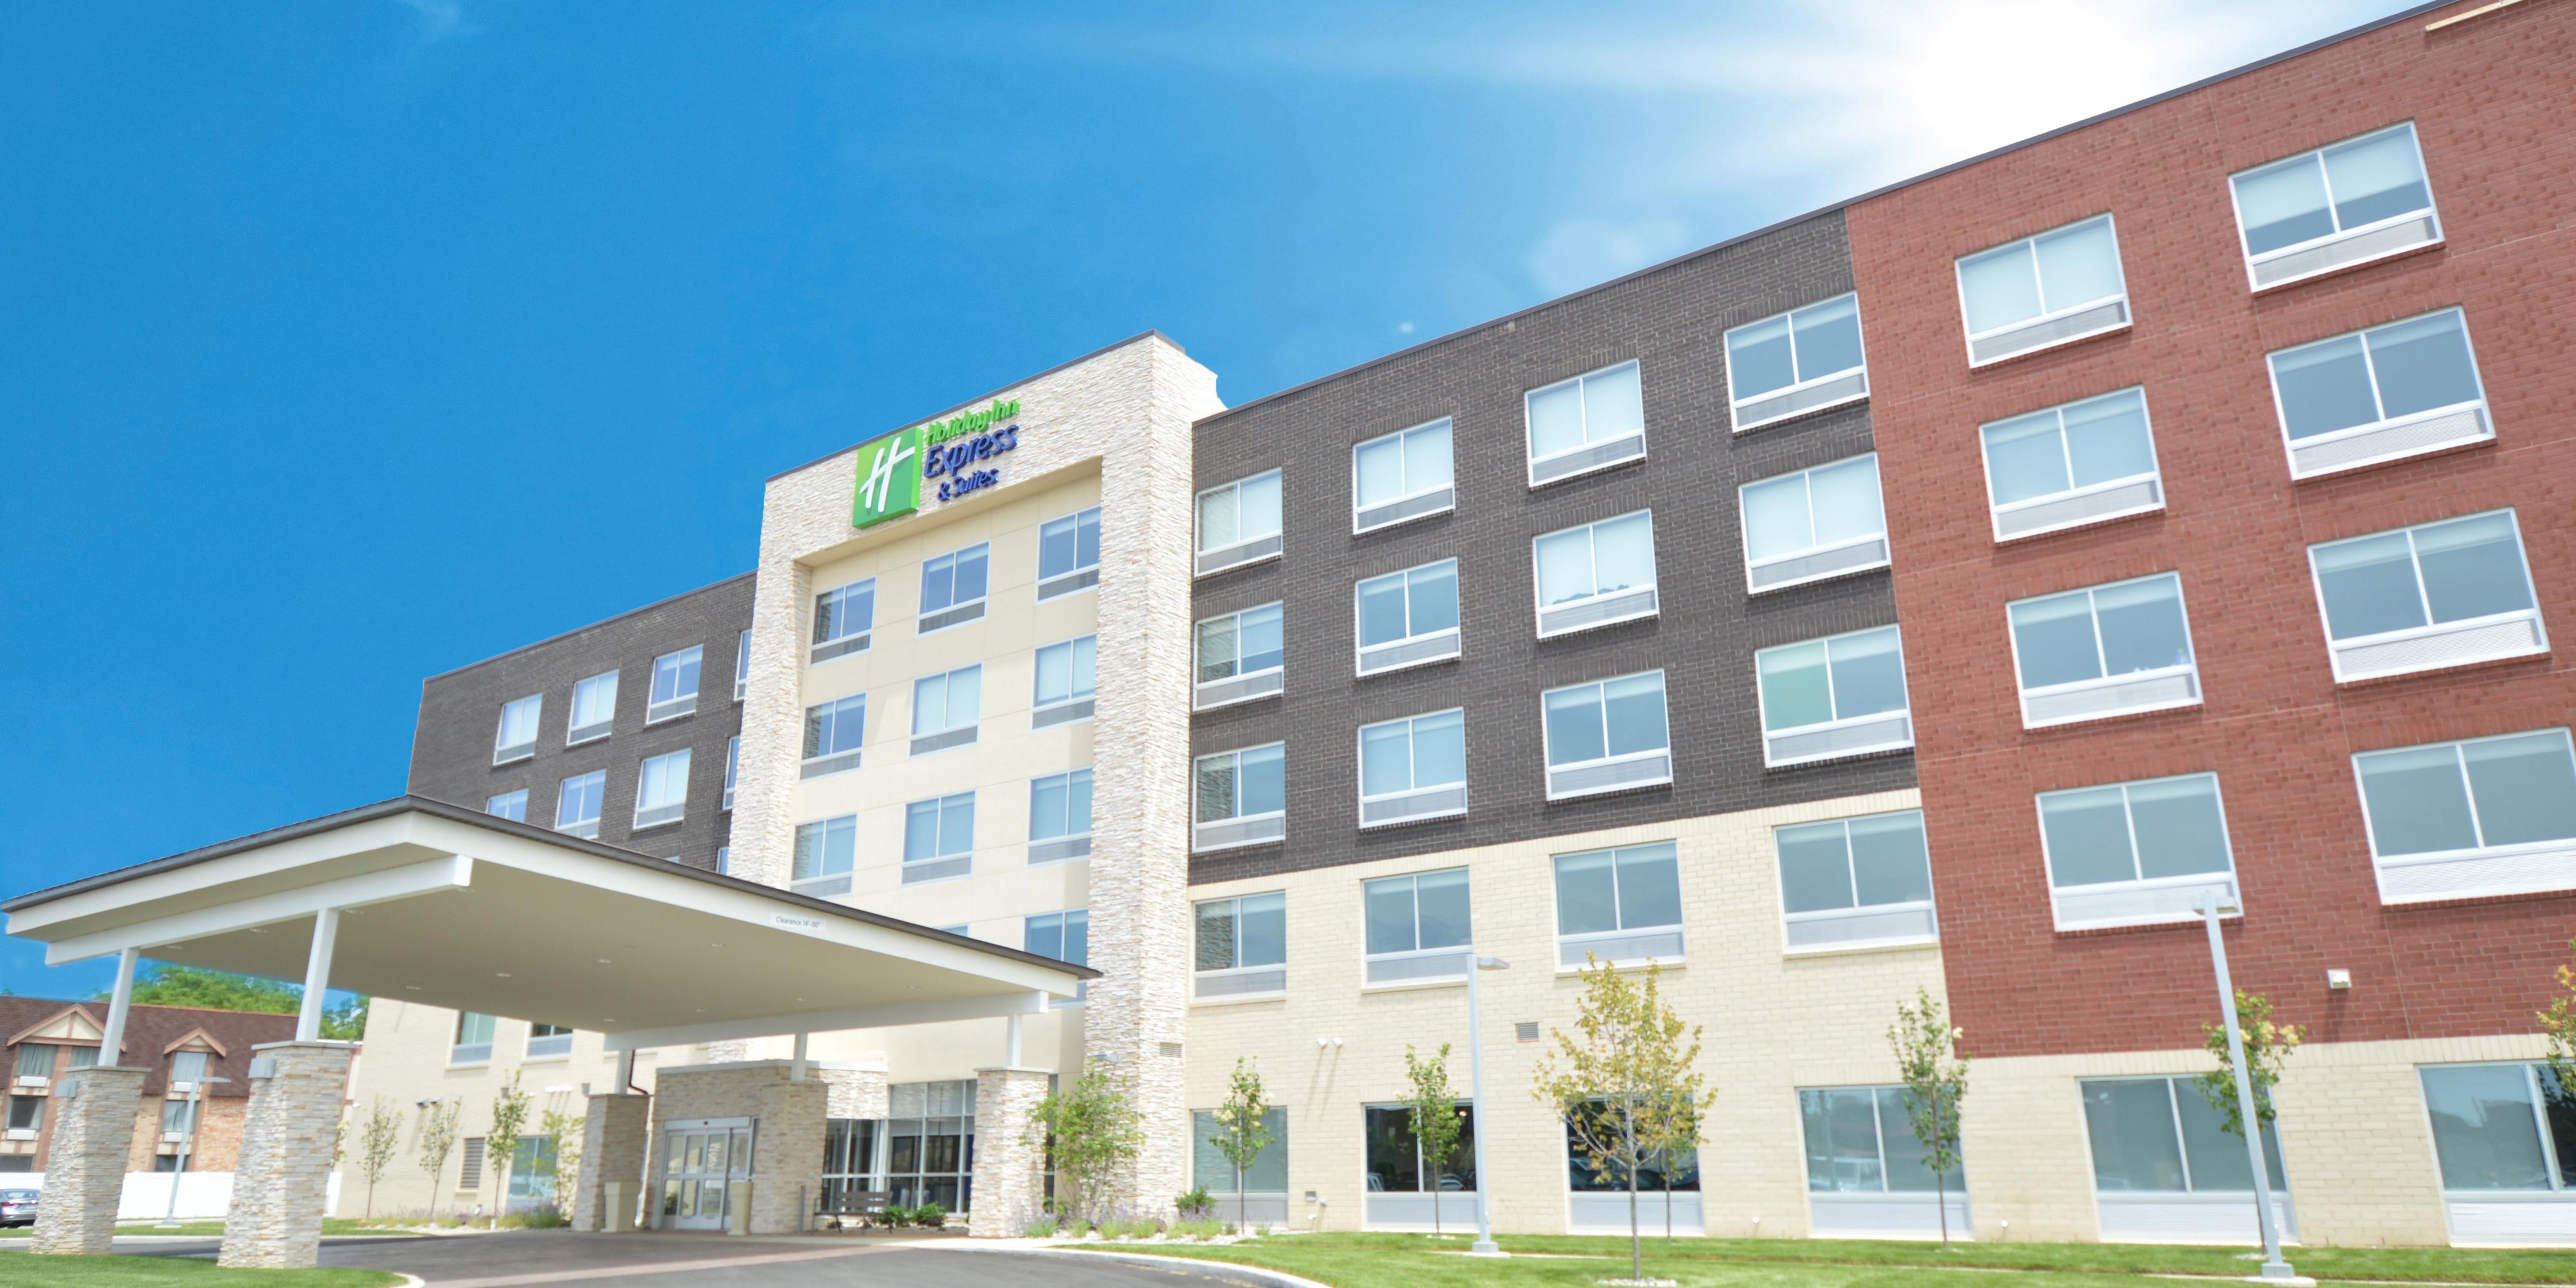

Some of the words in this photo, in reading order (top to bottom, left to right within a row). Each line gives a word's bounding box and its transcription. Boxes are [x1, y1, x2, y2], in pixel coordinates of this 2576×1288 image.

[926, 410, 992, 446] Holiday
[991, 399, 1020, 422] Inn
[923, 424, 1019, 478] Express
[937, 481, 950, 501] &
[951, 468, 999, 498] Suites
[775, 916, 802, 926] Clearance
